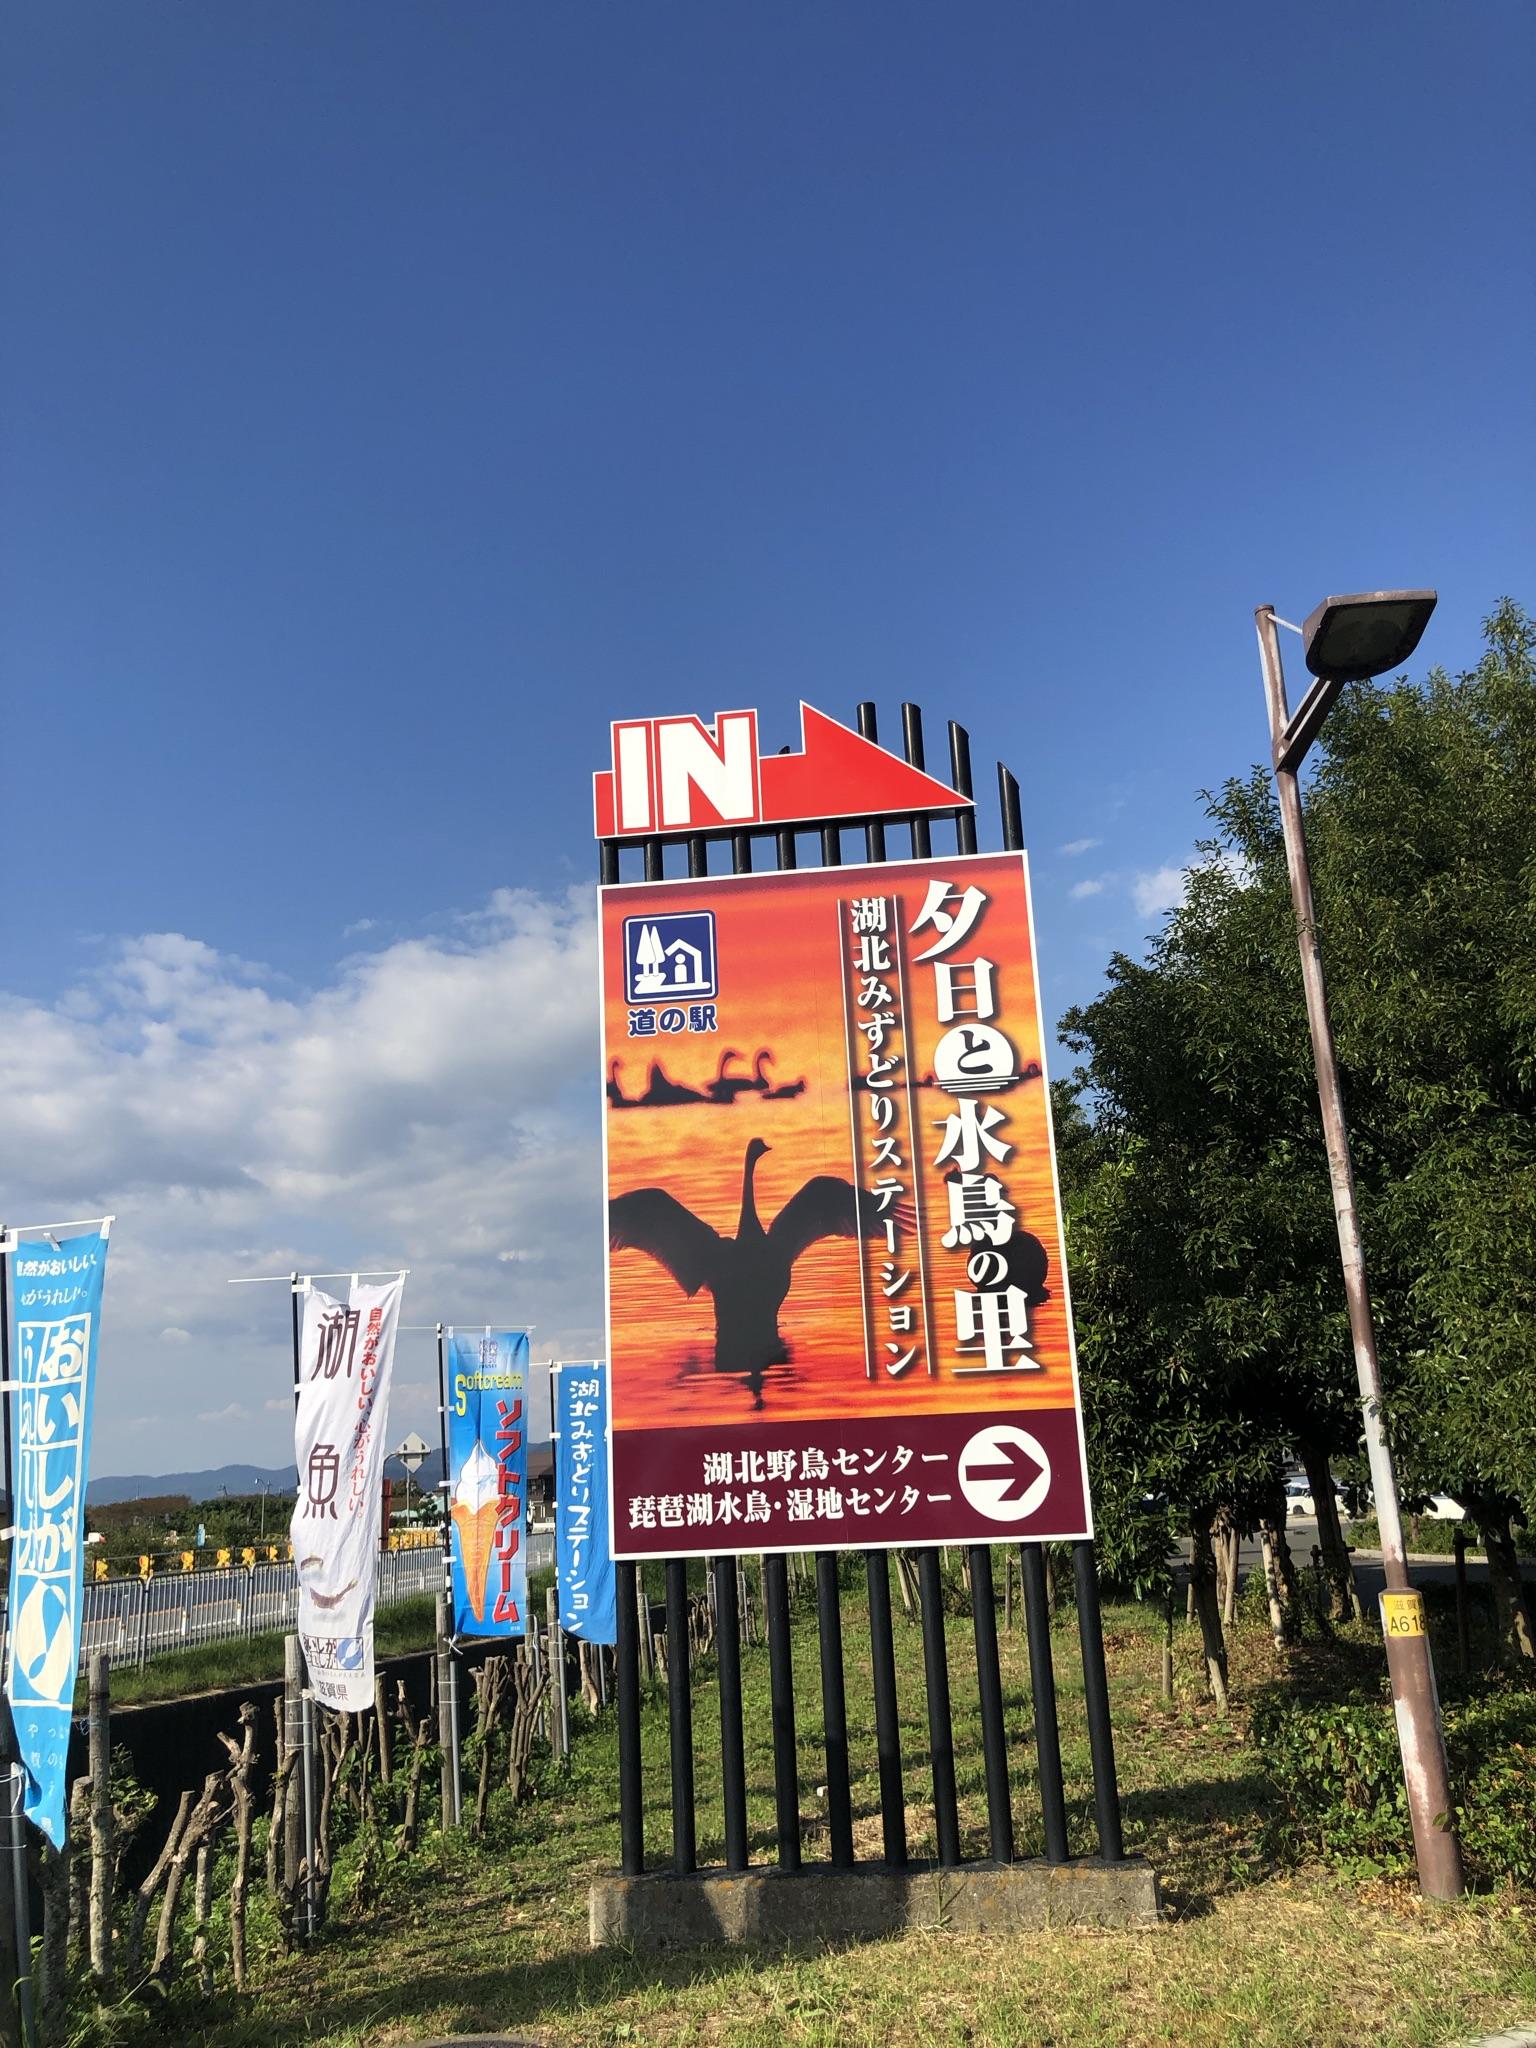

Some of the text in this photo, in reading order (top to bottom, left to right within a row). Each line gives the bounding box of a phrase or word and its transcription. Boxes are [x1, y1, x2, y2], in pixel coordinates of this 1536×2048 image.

[617, 714, 754, 831] IN
[628, 1004, 717, 1038] 道の駅
[850, 896, 917, 1377] 湖北みずどりステーション
[909, 878, 1041, 1373] 夕日と水鳥の里
[492, 1397, 523, 1624] ソフトクリーム
[566, 1379, 599, 1632] 湖北みずどりステーション
[628, 1486, 952, 1529] 琵琶湖水鳥・湿地センター
[702, 1444, 950, 1486] 湖北野鳥センター
